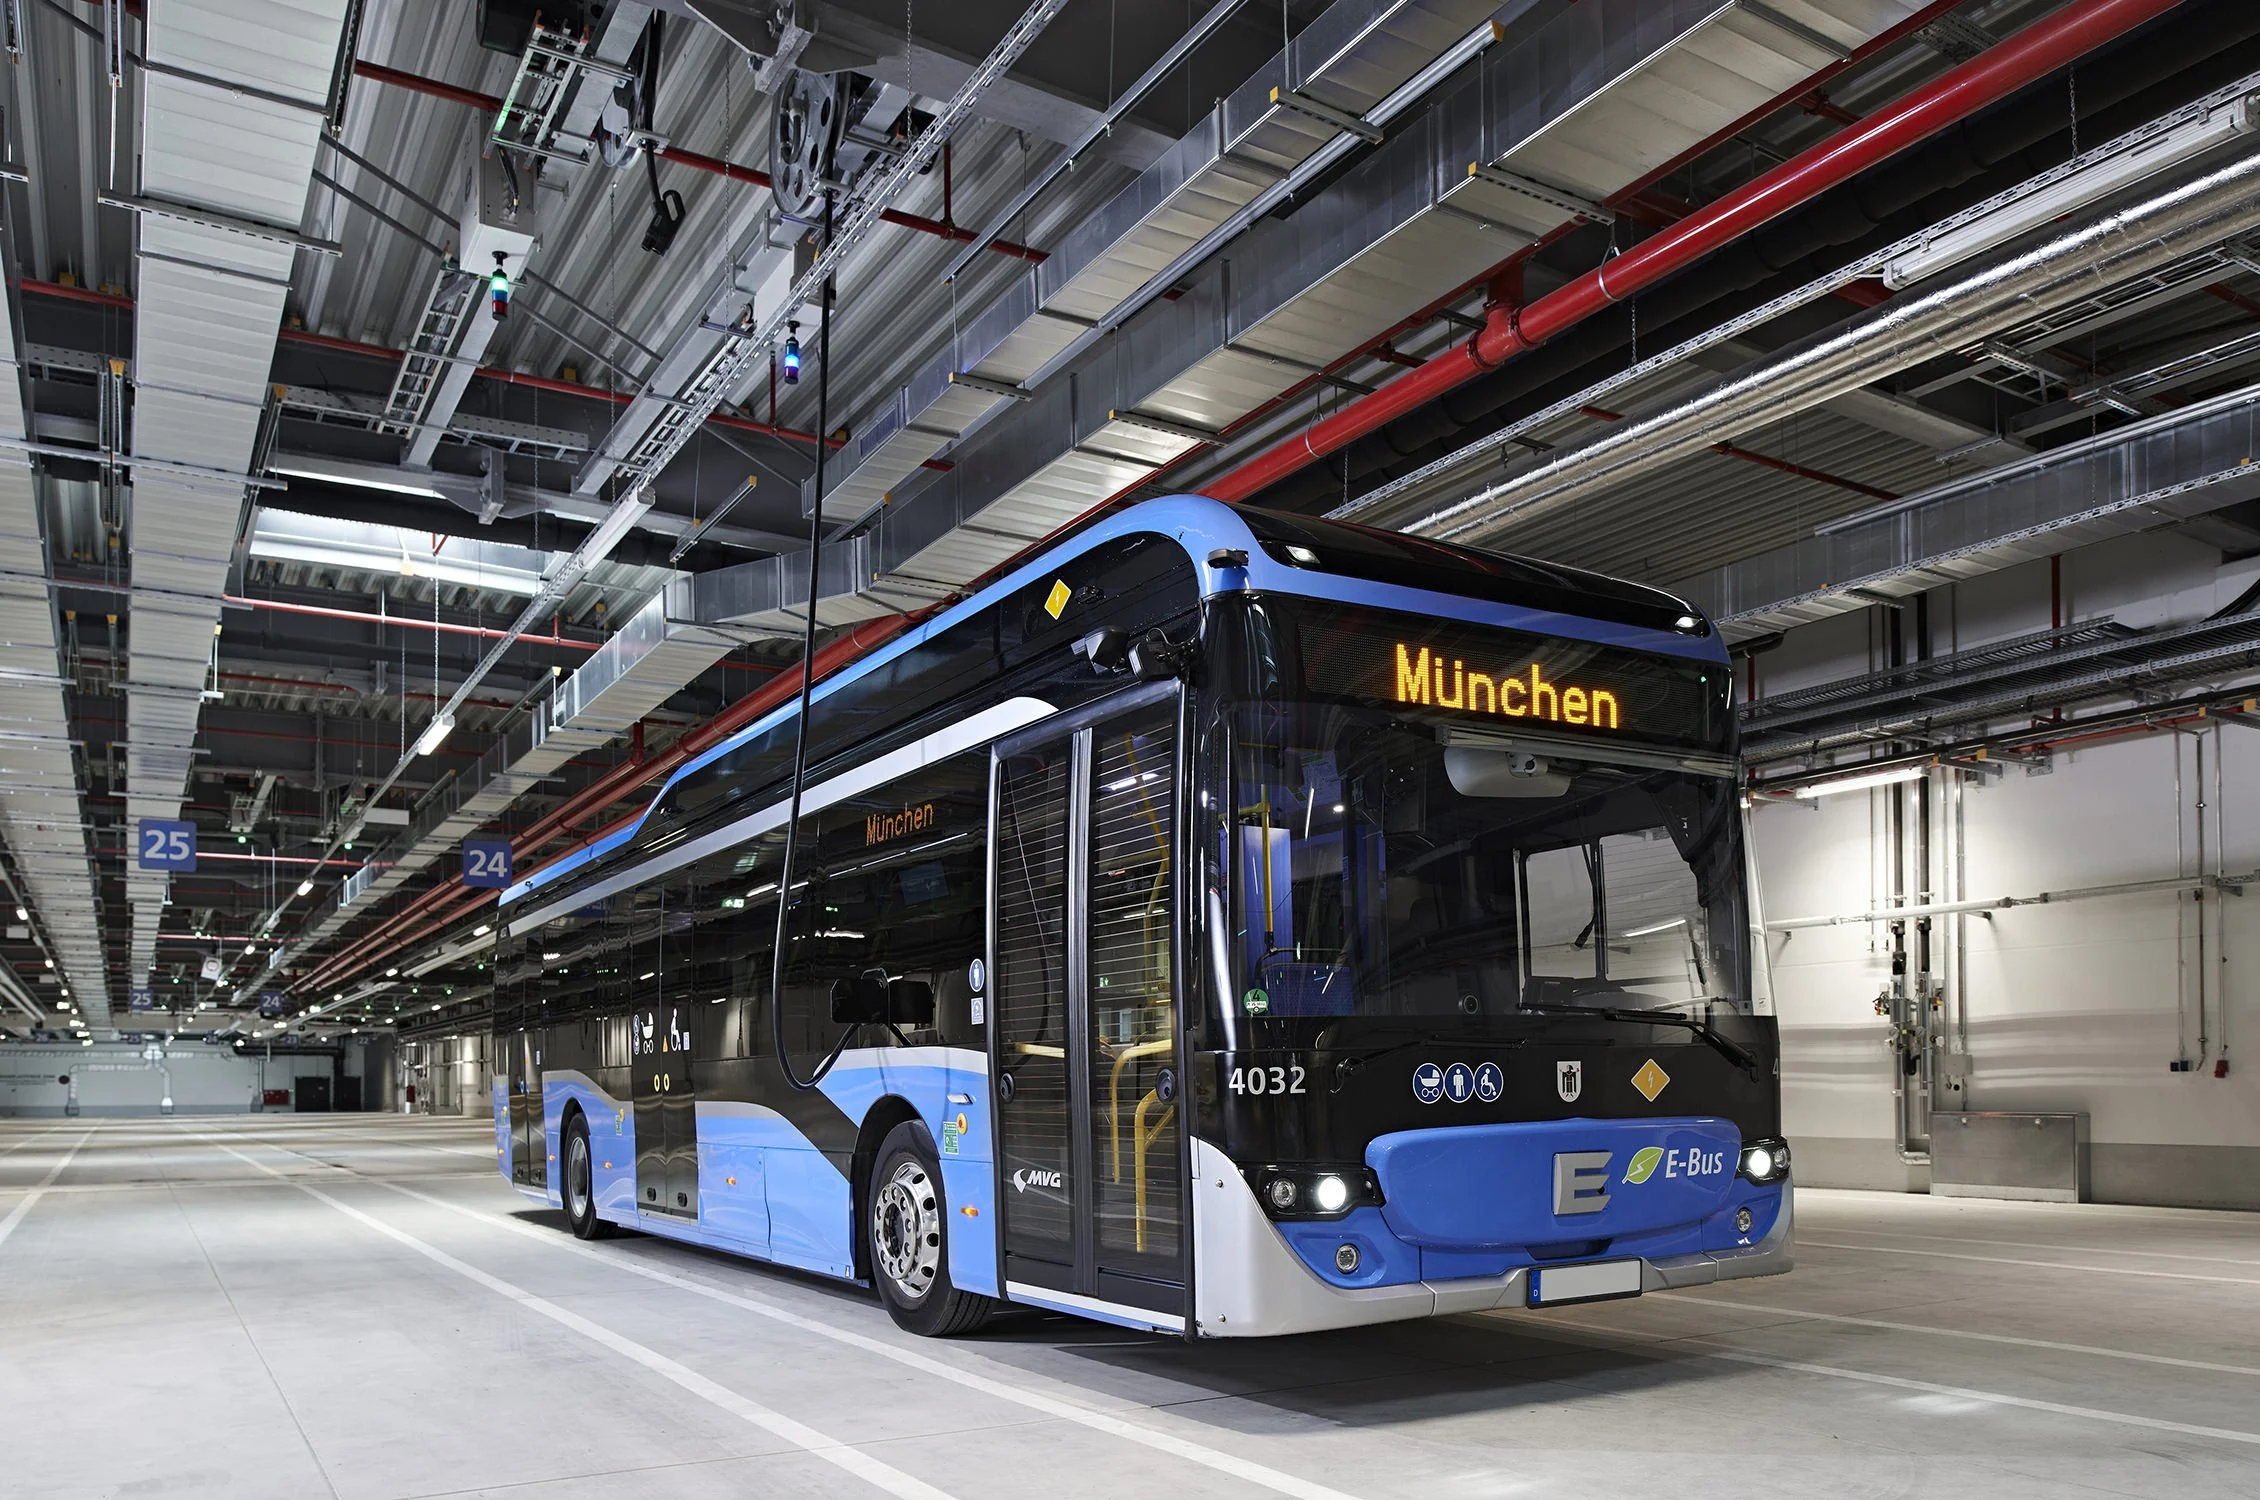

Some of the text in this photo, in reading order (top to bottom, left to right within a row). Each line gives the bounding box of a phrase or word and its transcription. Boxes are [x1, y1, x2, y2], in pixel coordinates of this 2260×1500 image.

[1396, 643, 1618, 729] München
[866, 801, 933, 846] München
[144, 829, 190, 861] 25
[468, 849, 508, 878] 24
[132, 994, 151, 1006] 25
[262, 996, 281, 1008] 24
[1252, 989, 1261, 1002] 4
[1228, 1066, 1306, 1095] 4032
[1665, 1147, 1723, 1179] E-Bus
[1026, 1170, 1061, 1188] MVG
[1533, 1289, 1539, 1297] D
